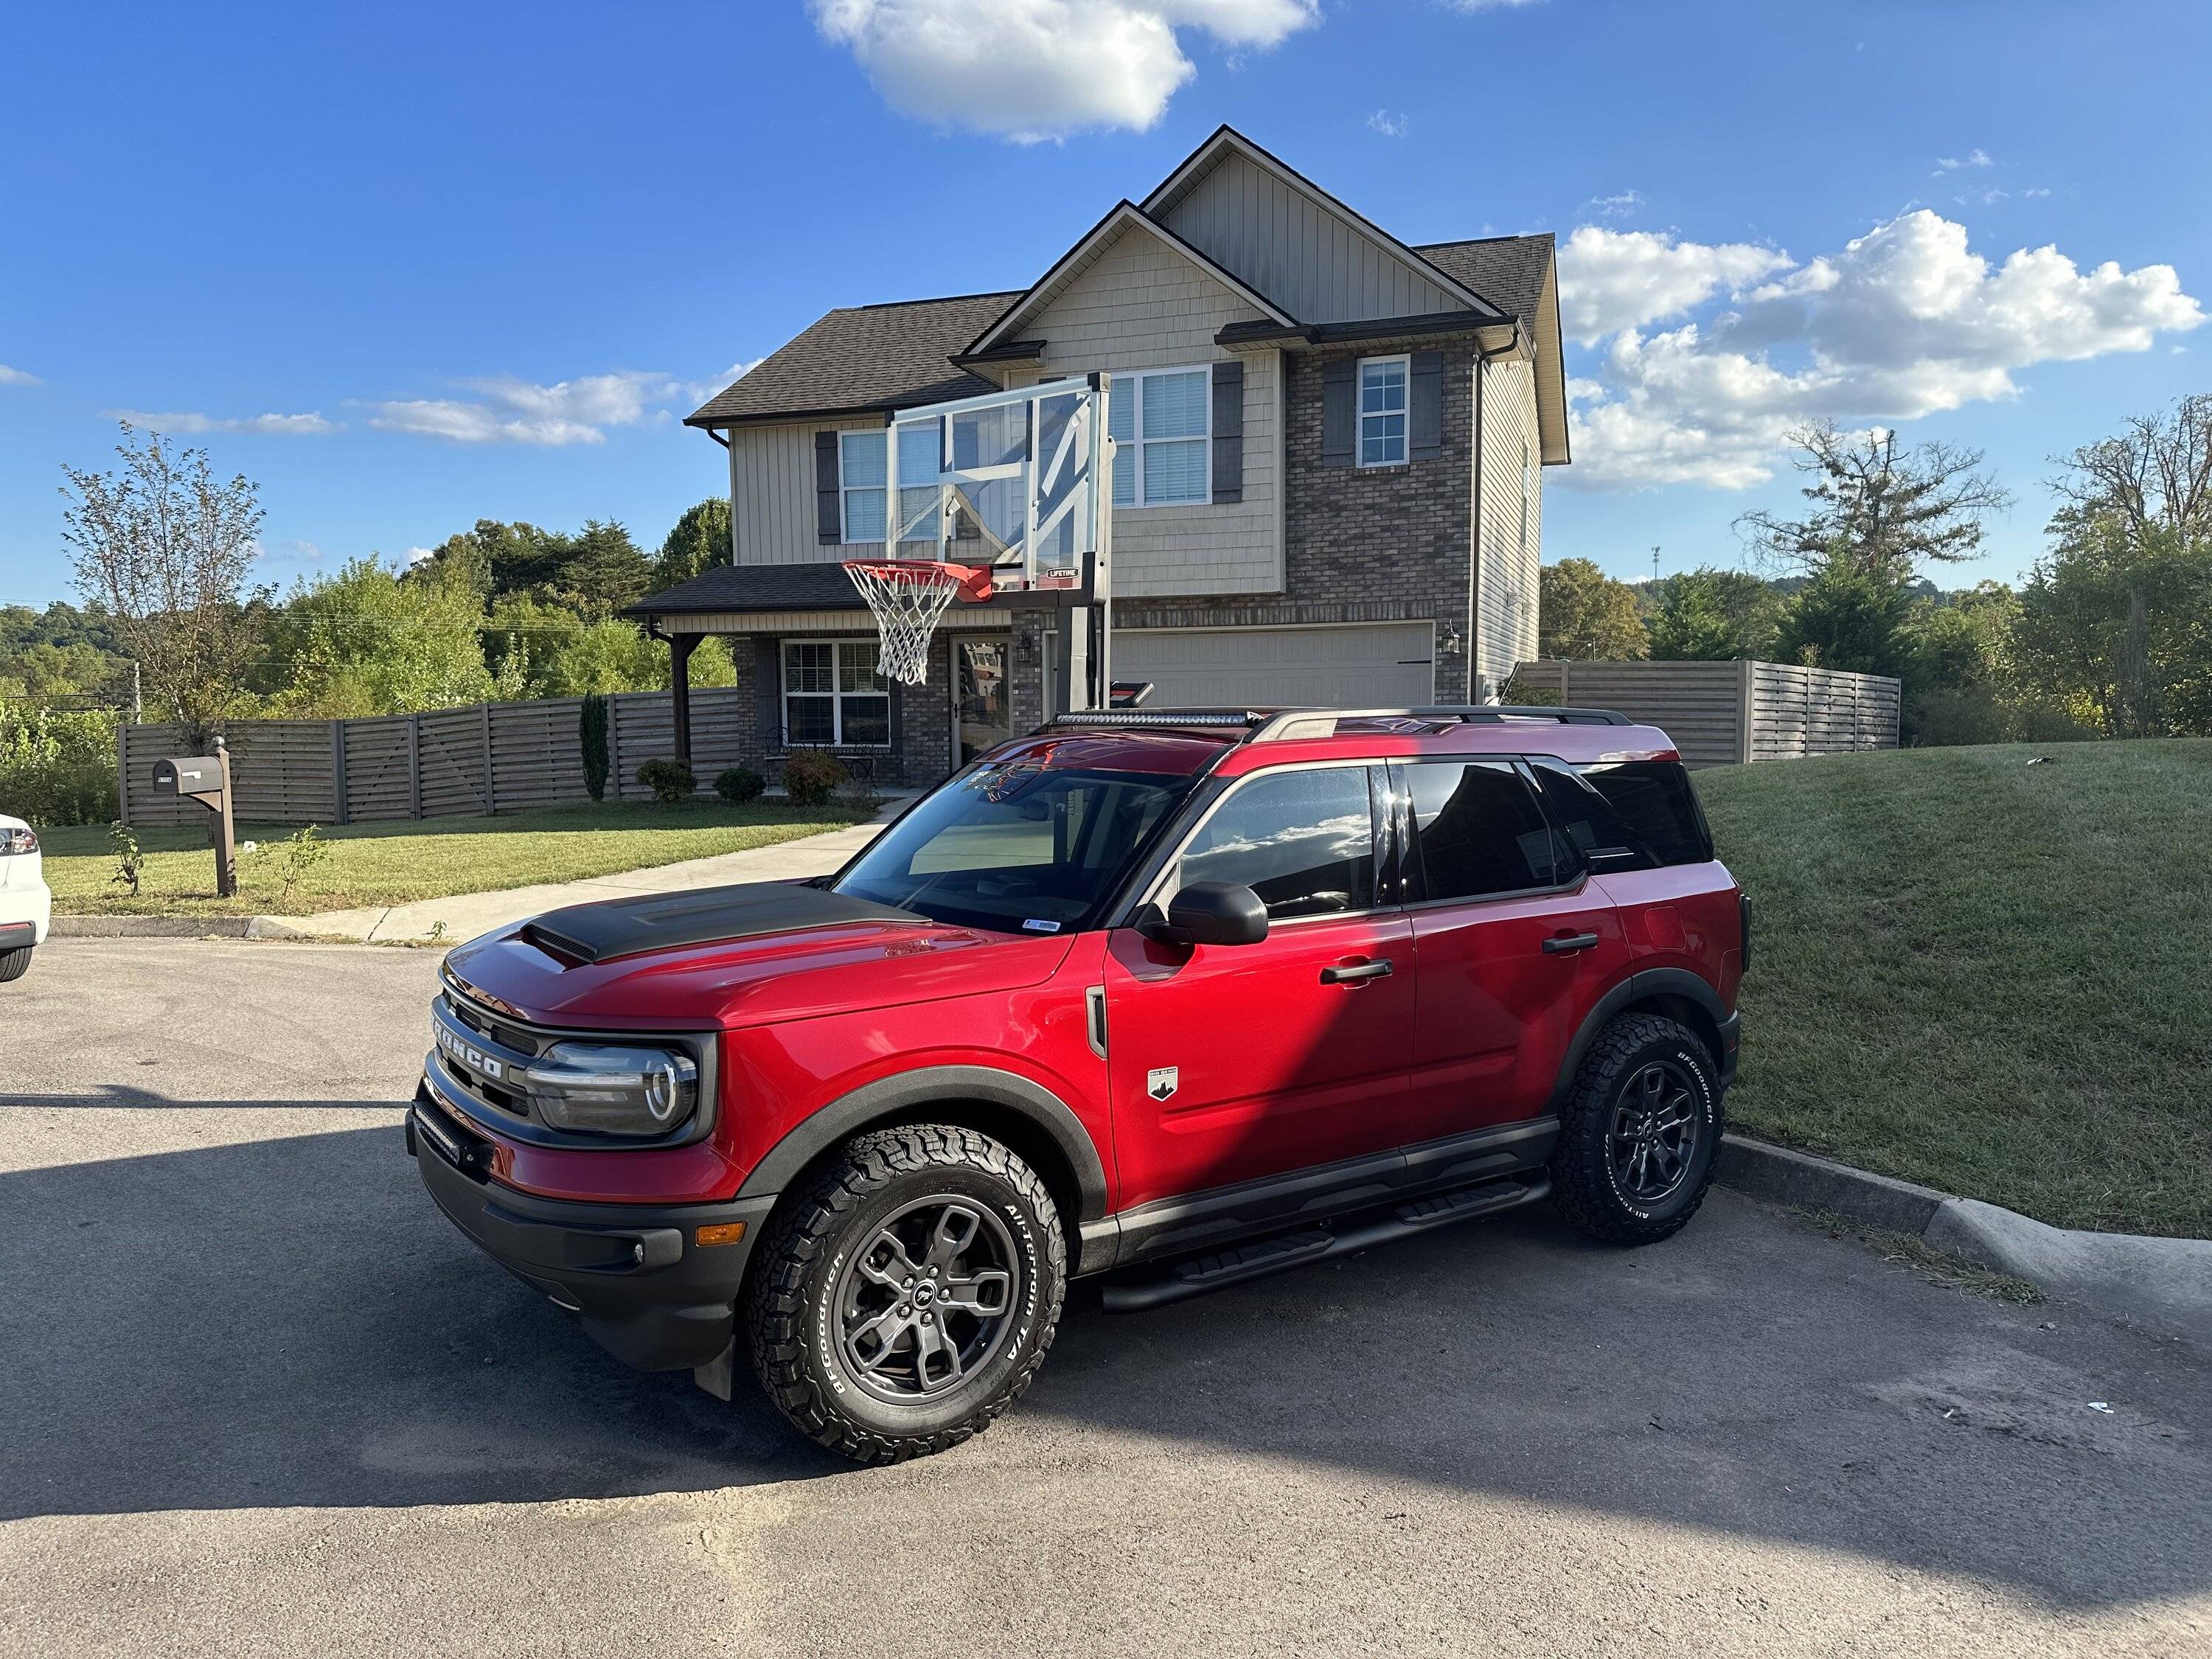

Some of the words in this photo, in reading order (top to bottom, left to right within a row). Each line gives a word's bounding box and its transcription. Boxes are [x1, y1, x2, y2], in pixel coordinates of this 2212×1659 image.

[1677, 1051, 1713, 1123] BFGoodrich
[1004, 1204, 1038, 1316] All-Terrain
[818, 1253, 846, 1394] BFGoodrich
[1006, 1326, 1029, 1360] T/A
